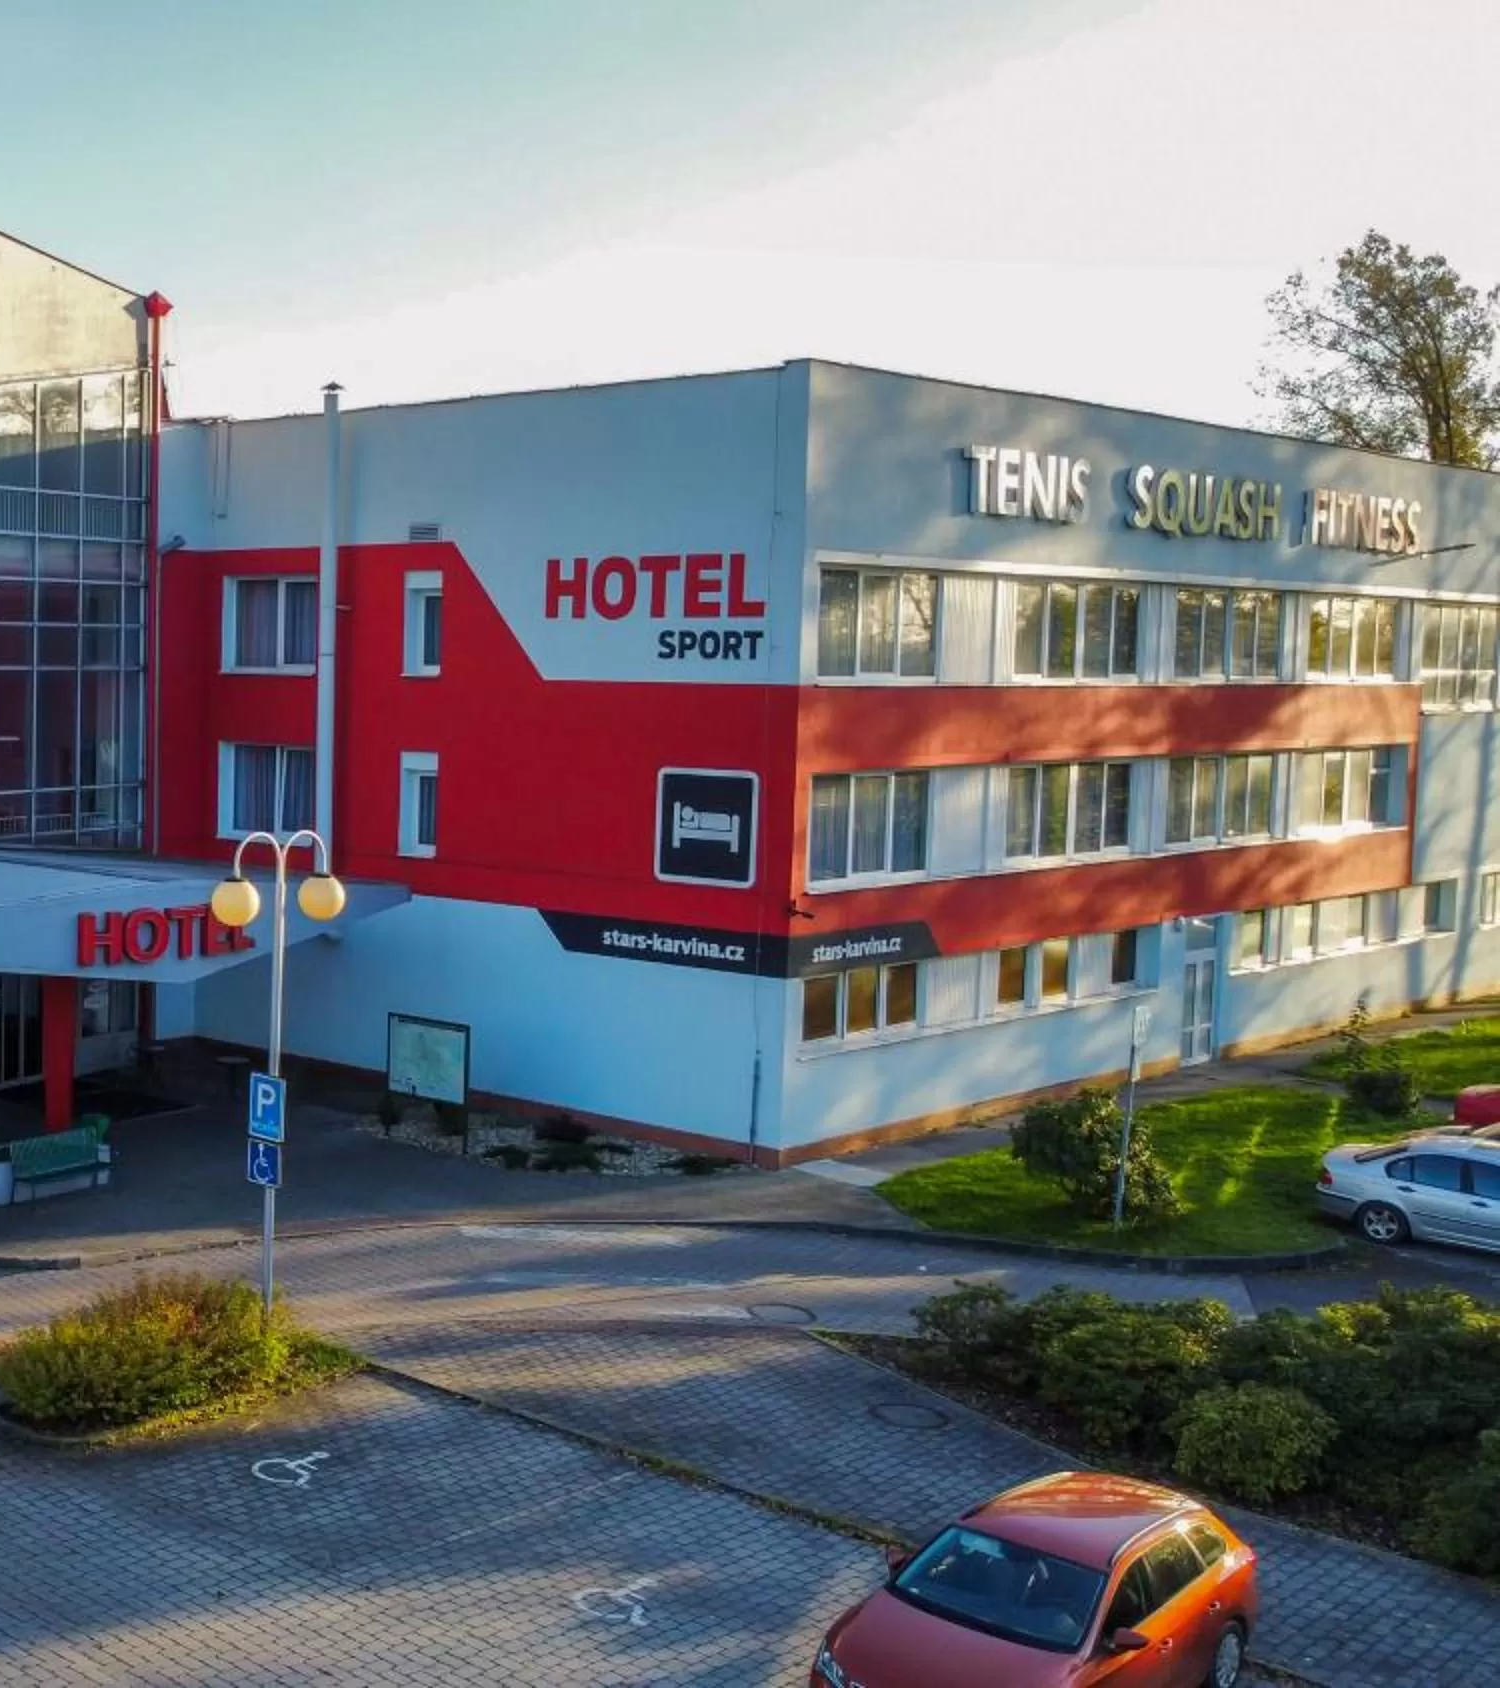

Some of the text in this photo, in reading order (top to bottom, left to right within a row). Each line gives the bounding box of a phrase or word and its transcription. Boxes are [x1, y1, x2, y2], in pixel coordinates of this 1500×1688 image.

[970, 443, 1422, 554] TENIS SQUASH FITNESS
[545, 553, 766, 620] HOTEL
[657, 629, 764, 661] SPORT
[603, 928, 746, 962] stars-karvina.cz
[811, 935, 902, 963] stars-karvina.cz
[257, 1082, 277, 1118] P
